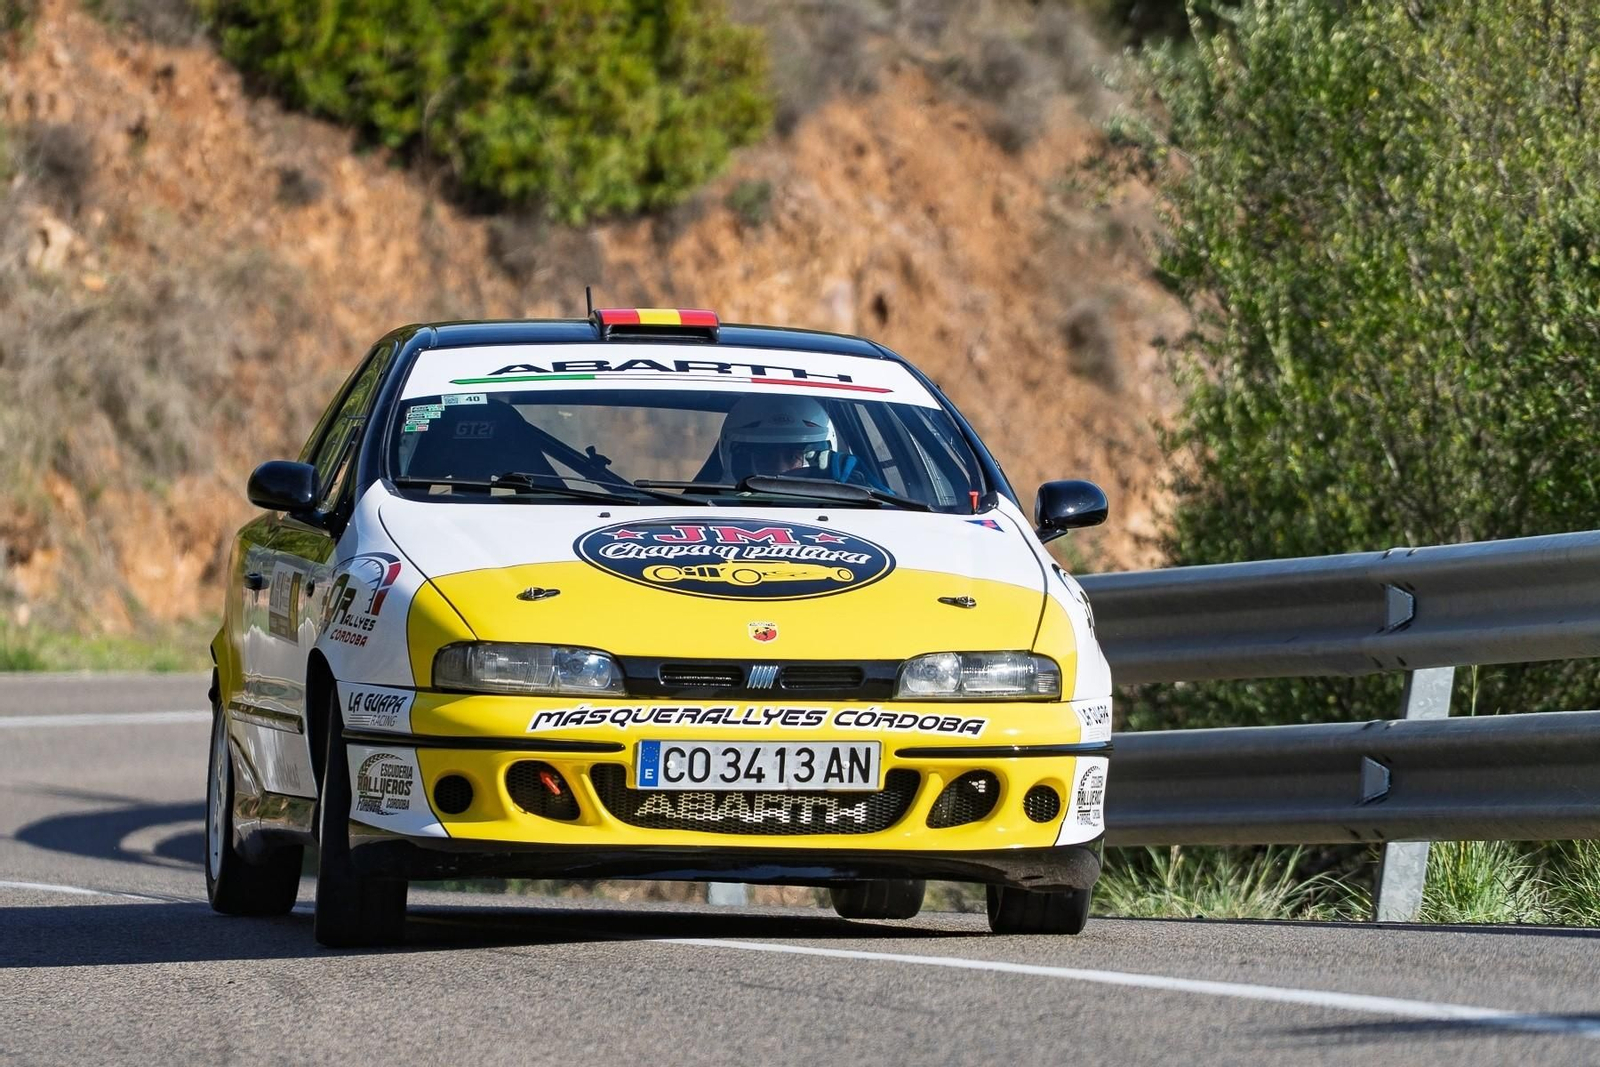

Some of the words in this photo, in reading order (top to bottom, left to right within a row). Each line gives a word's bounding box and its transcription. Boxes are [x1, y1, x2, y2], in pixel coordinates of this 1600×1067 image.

[487, 358, 854, 383] ABARTH
[652, 525, 801, 545] JM
[598, 541, 713, 560] Chapa
[712, 544, 741, 561] y
[742, 543, 873, 565] pintura
[347, 691, 363, 714] LA
[363, 692, 408, 715] GUAPA
[369, 714, 398, 728] RACING
[530, 705, 828, 731] MÁSQUERALLYES
[833, 706, 986, 736] CÓRDOBA
[380, 763, 413, 780] ESCUDERIA
[644, 768, 654, 780] E
[662, 746, 712, 784] CO
[719, 746, 816, 784] 3413
[822, 746, 872, 784] AN
[357, 775, 413, 800] RALLYEROS
[634, 791, 868, 826] ABARTH
